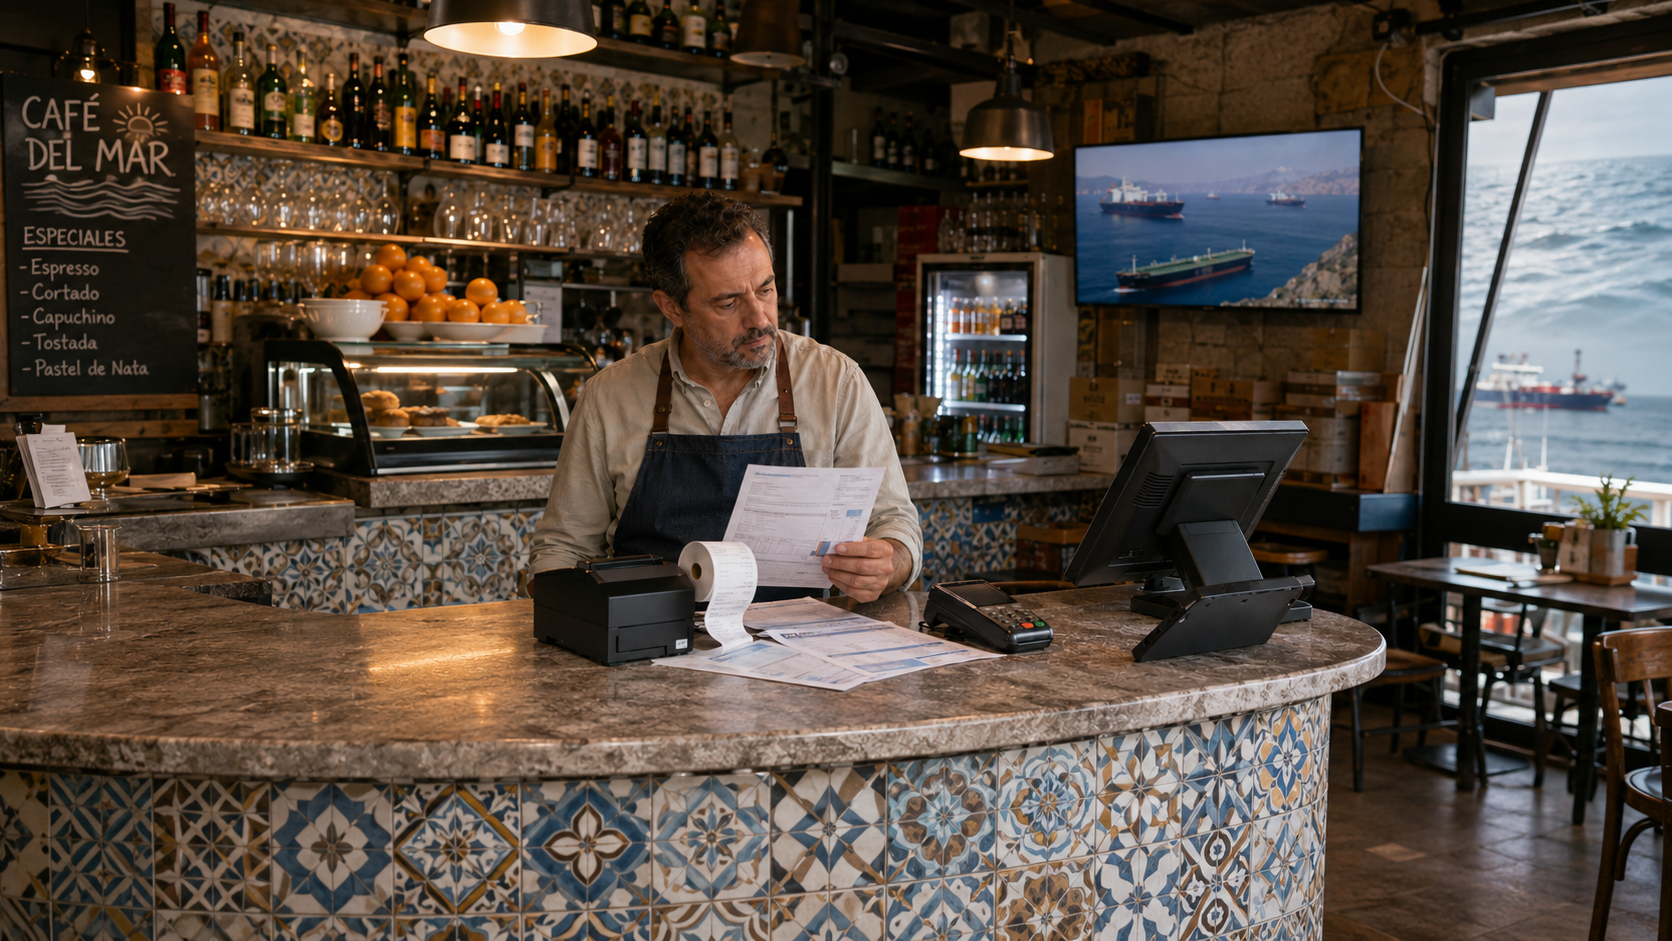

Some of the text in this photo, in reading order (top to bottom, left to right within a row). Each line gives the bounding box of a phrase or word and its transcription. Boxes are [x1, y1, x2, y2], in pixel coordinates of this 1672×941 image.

[22, 93, 100, 132] CAFÉ
[25, 137, 82, 171] DEL
[24, 226, 126, 248] ESPECIALES
[31, 258, 99, 281] Espresso
[32, 283, 100, 301] Cortado
[33, 307, 115, 330] Capuchino
[33, 333, 98, 351] Tostada
[35, 359, 81, 376] Pastel
[88, 360, 106, 376] de
[111, 360, 149, 376] Nata
